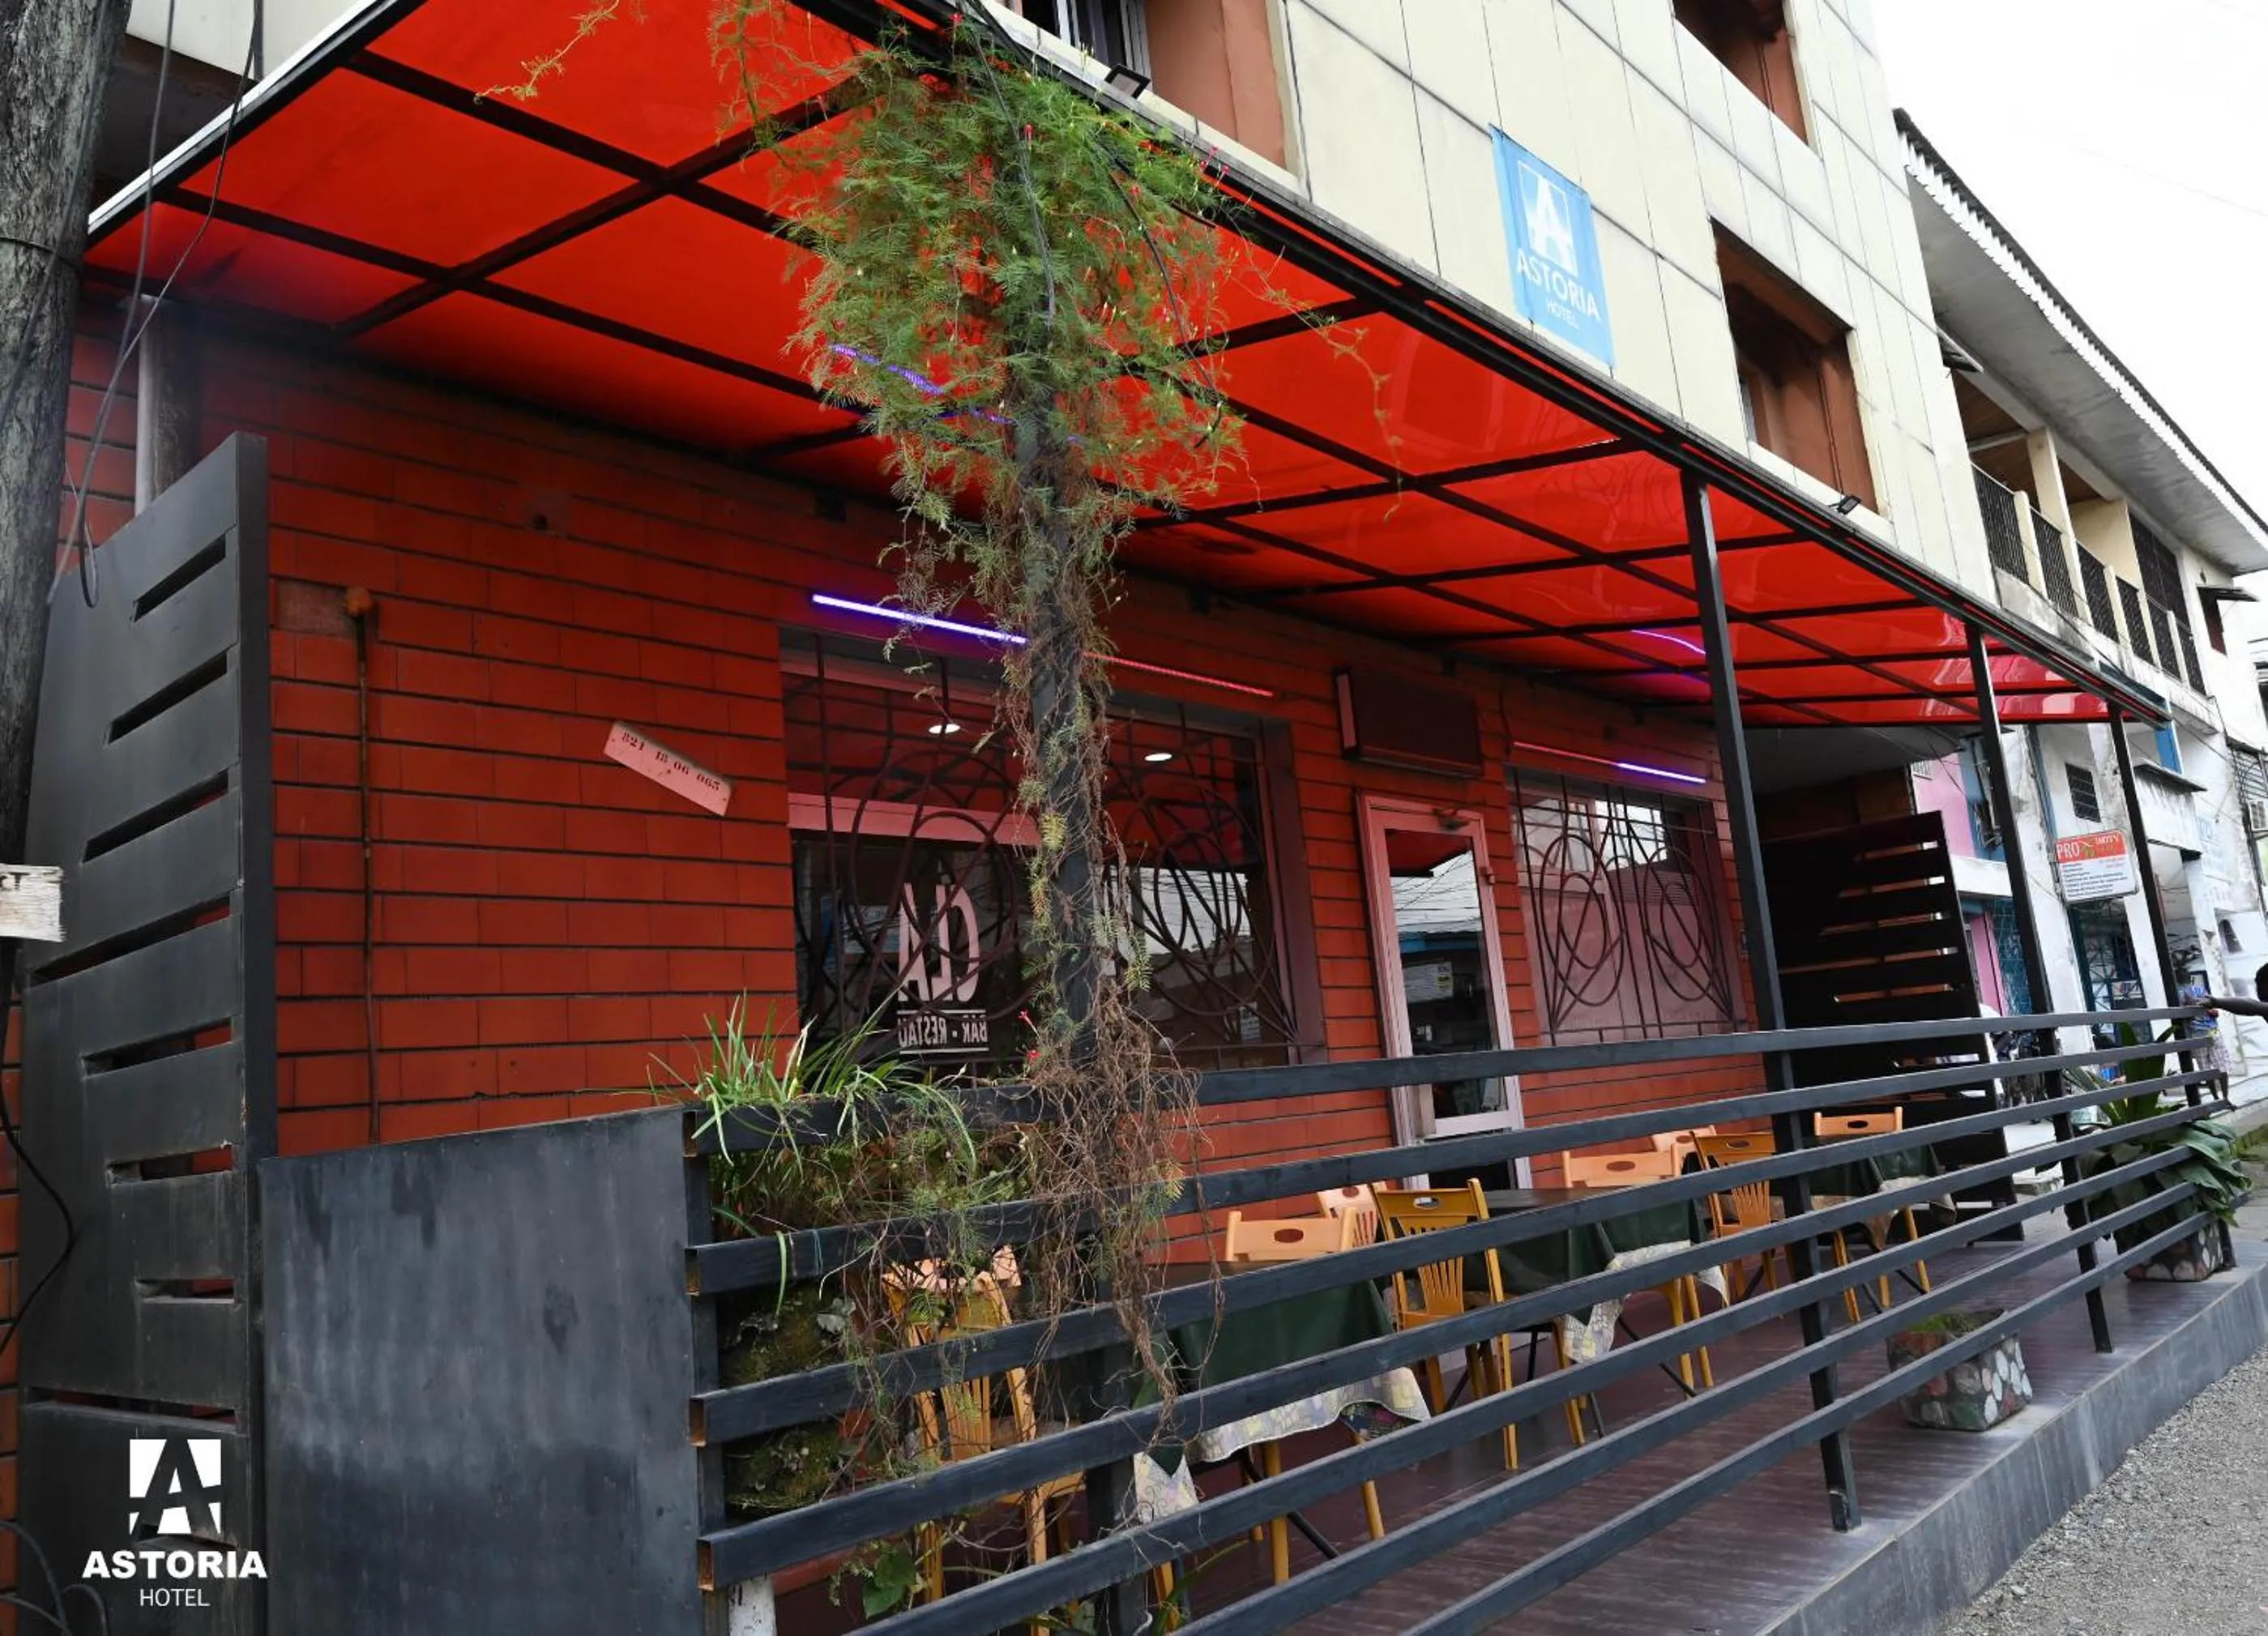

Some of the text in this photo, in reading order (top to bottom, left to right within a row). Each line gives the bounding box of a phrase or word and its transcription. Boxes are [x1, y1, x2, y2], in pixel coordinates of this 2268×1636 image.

[1516, 247, 1602, 322] ASTORIA
[1545, 297, 1579, 329] HOTEL
[2056, 841, 2080, 860] PRO
